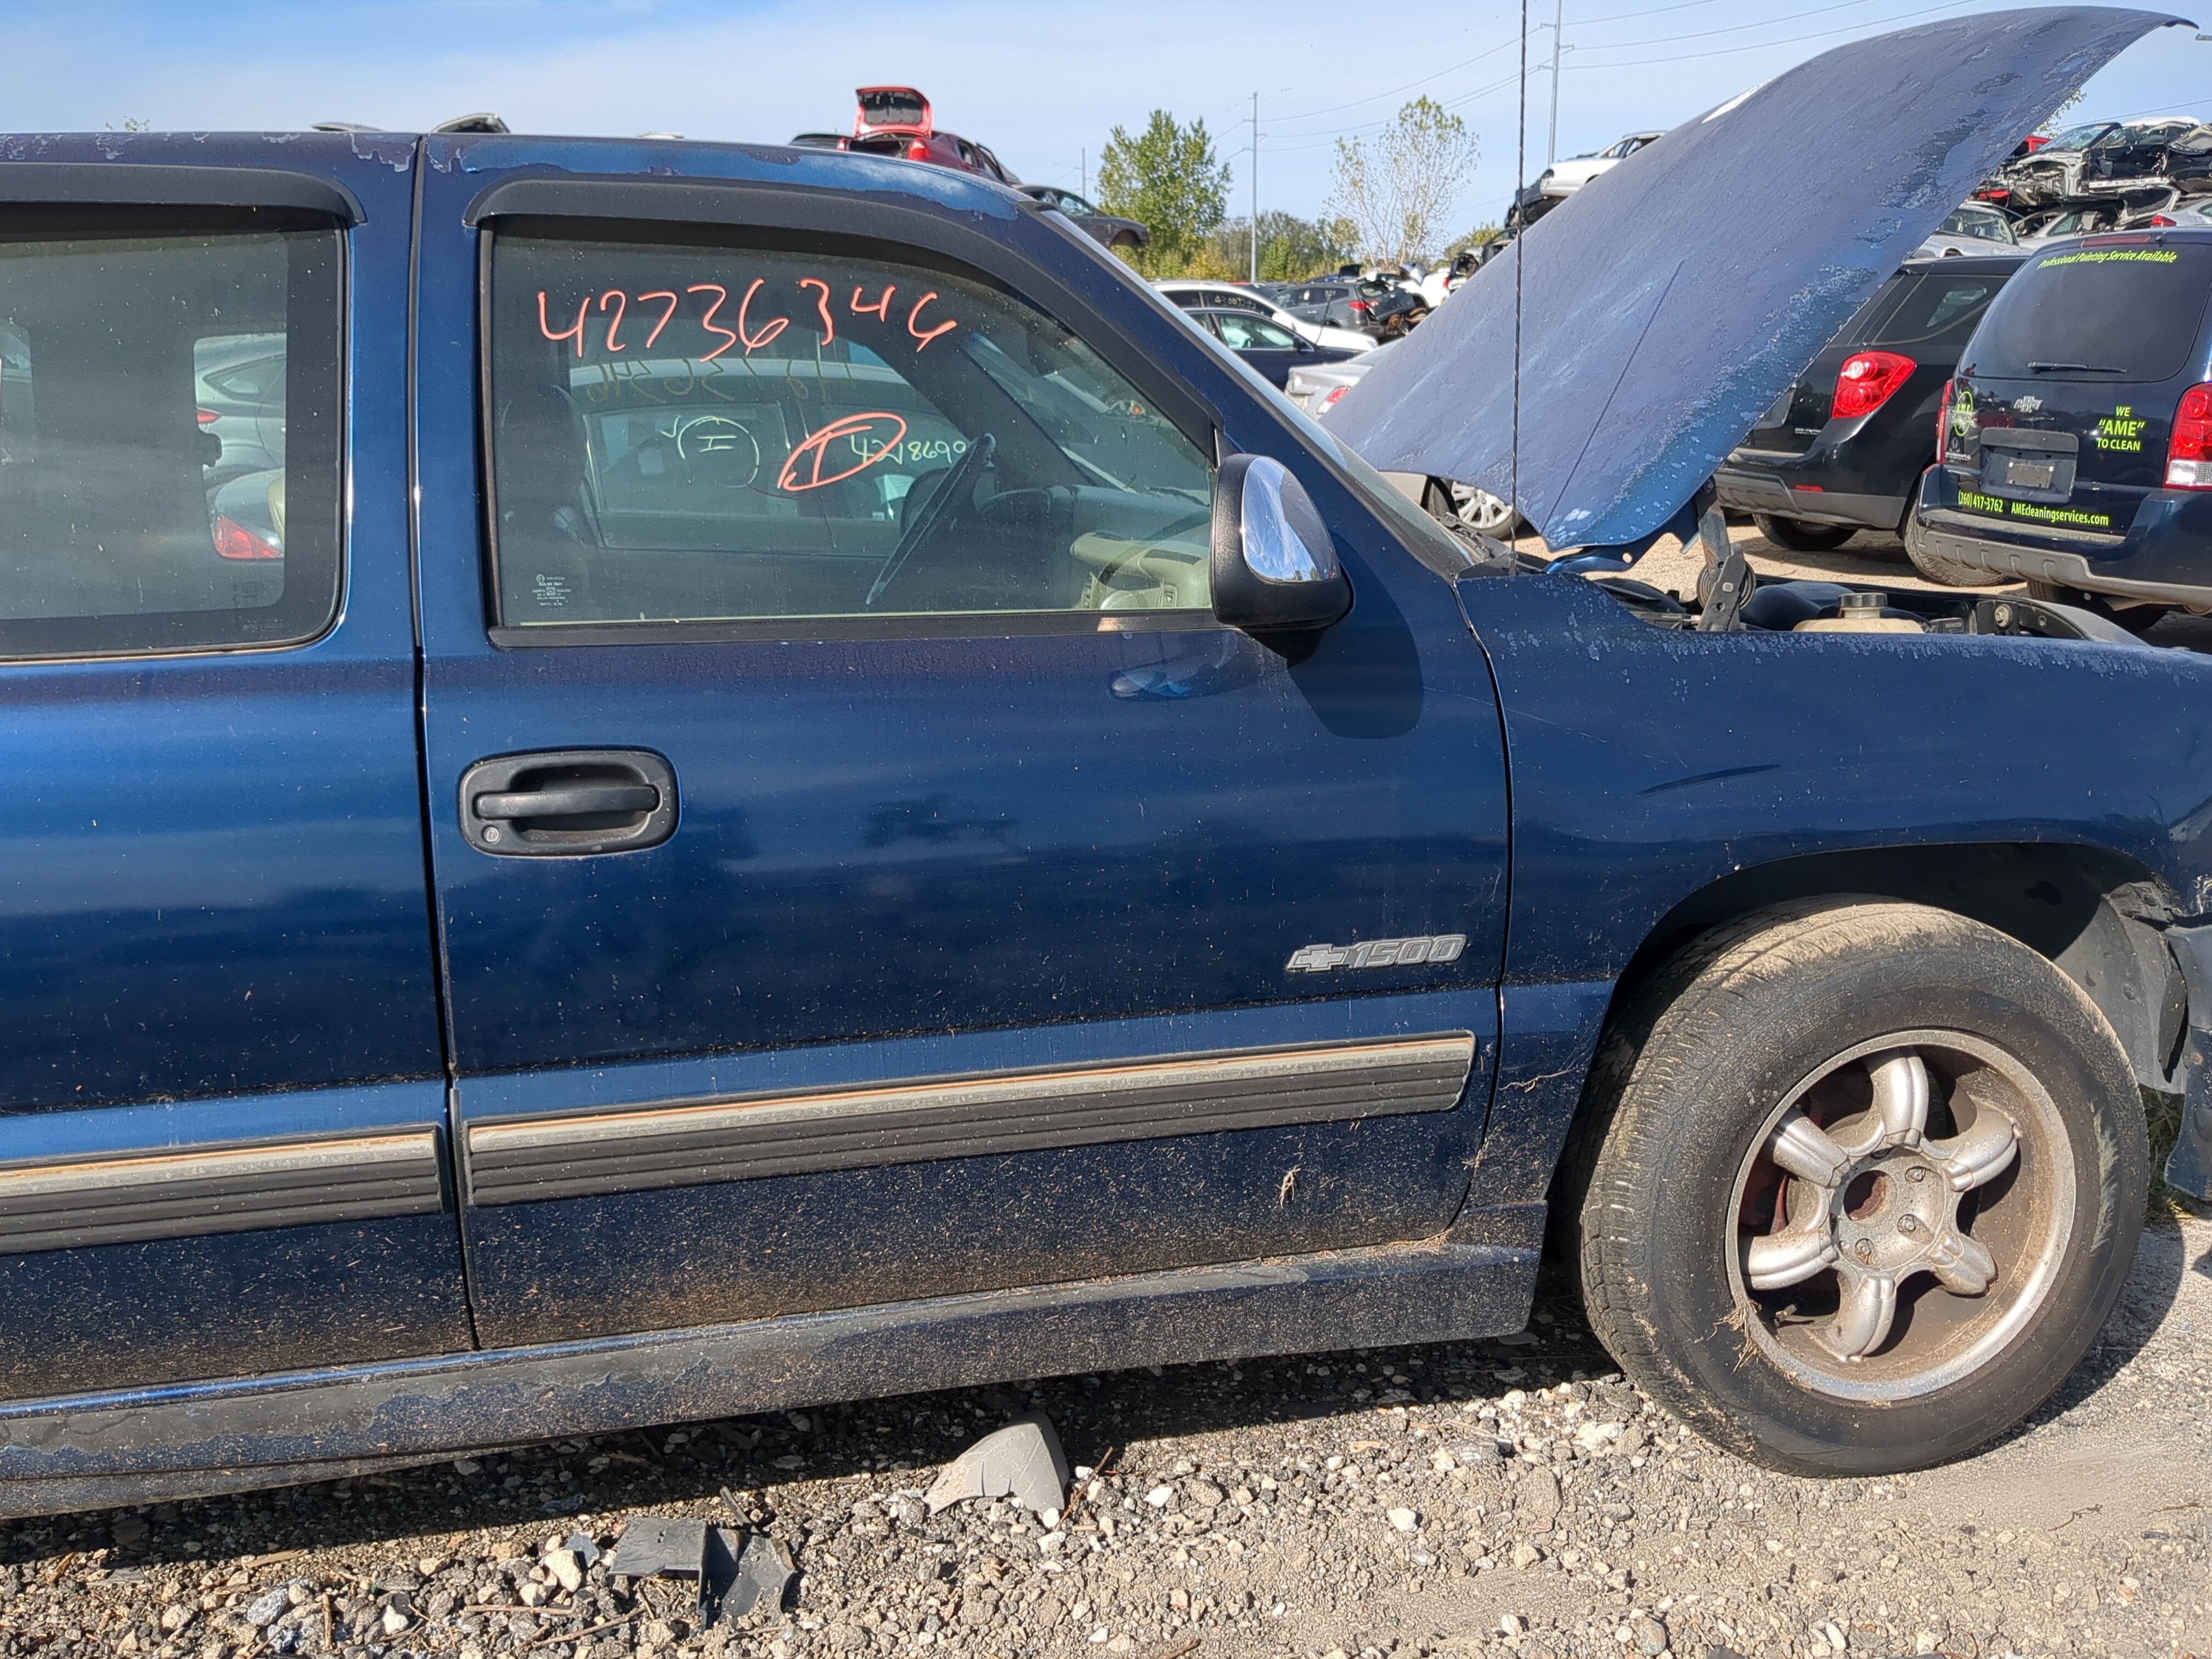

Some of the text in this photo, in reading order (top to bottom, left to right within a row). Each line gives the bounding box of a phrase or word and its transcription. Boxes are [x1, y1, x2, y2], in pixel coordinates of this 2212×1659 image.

[2037, 250, 2177, 269] Professional Painting Service Available
[2116, 406, 2131, 417] WE
[2096, 437, 2141, 451] TO CLEAN
[1958, 490, 2003, 512] (260) 417-3762
[2011, 502, 2109, 526] AMEcleaningservices.com
[1351, 935, 1468, 968] 1500
